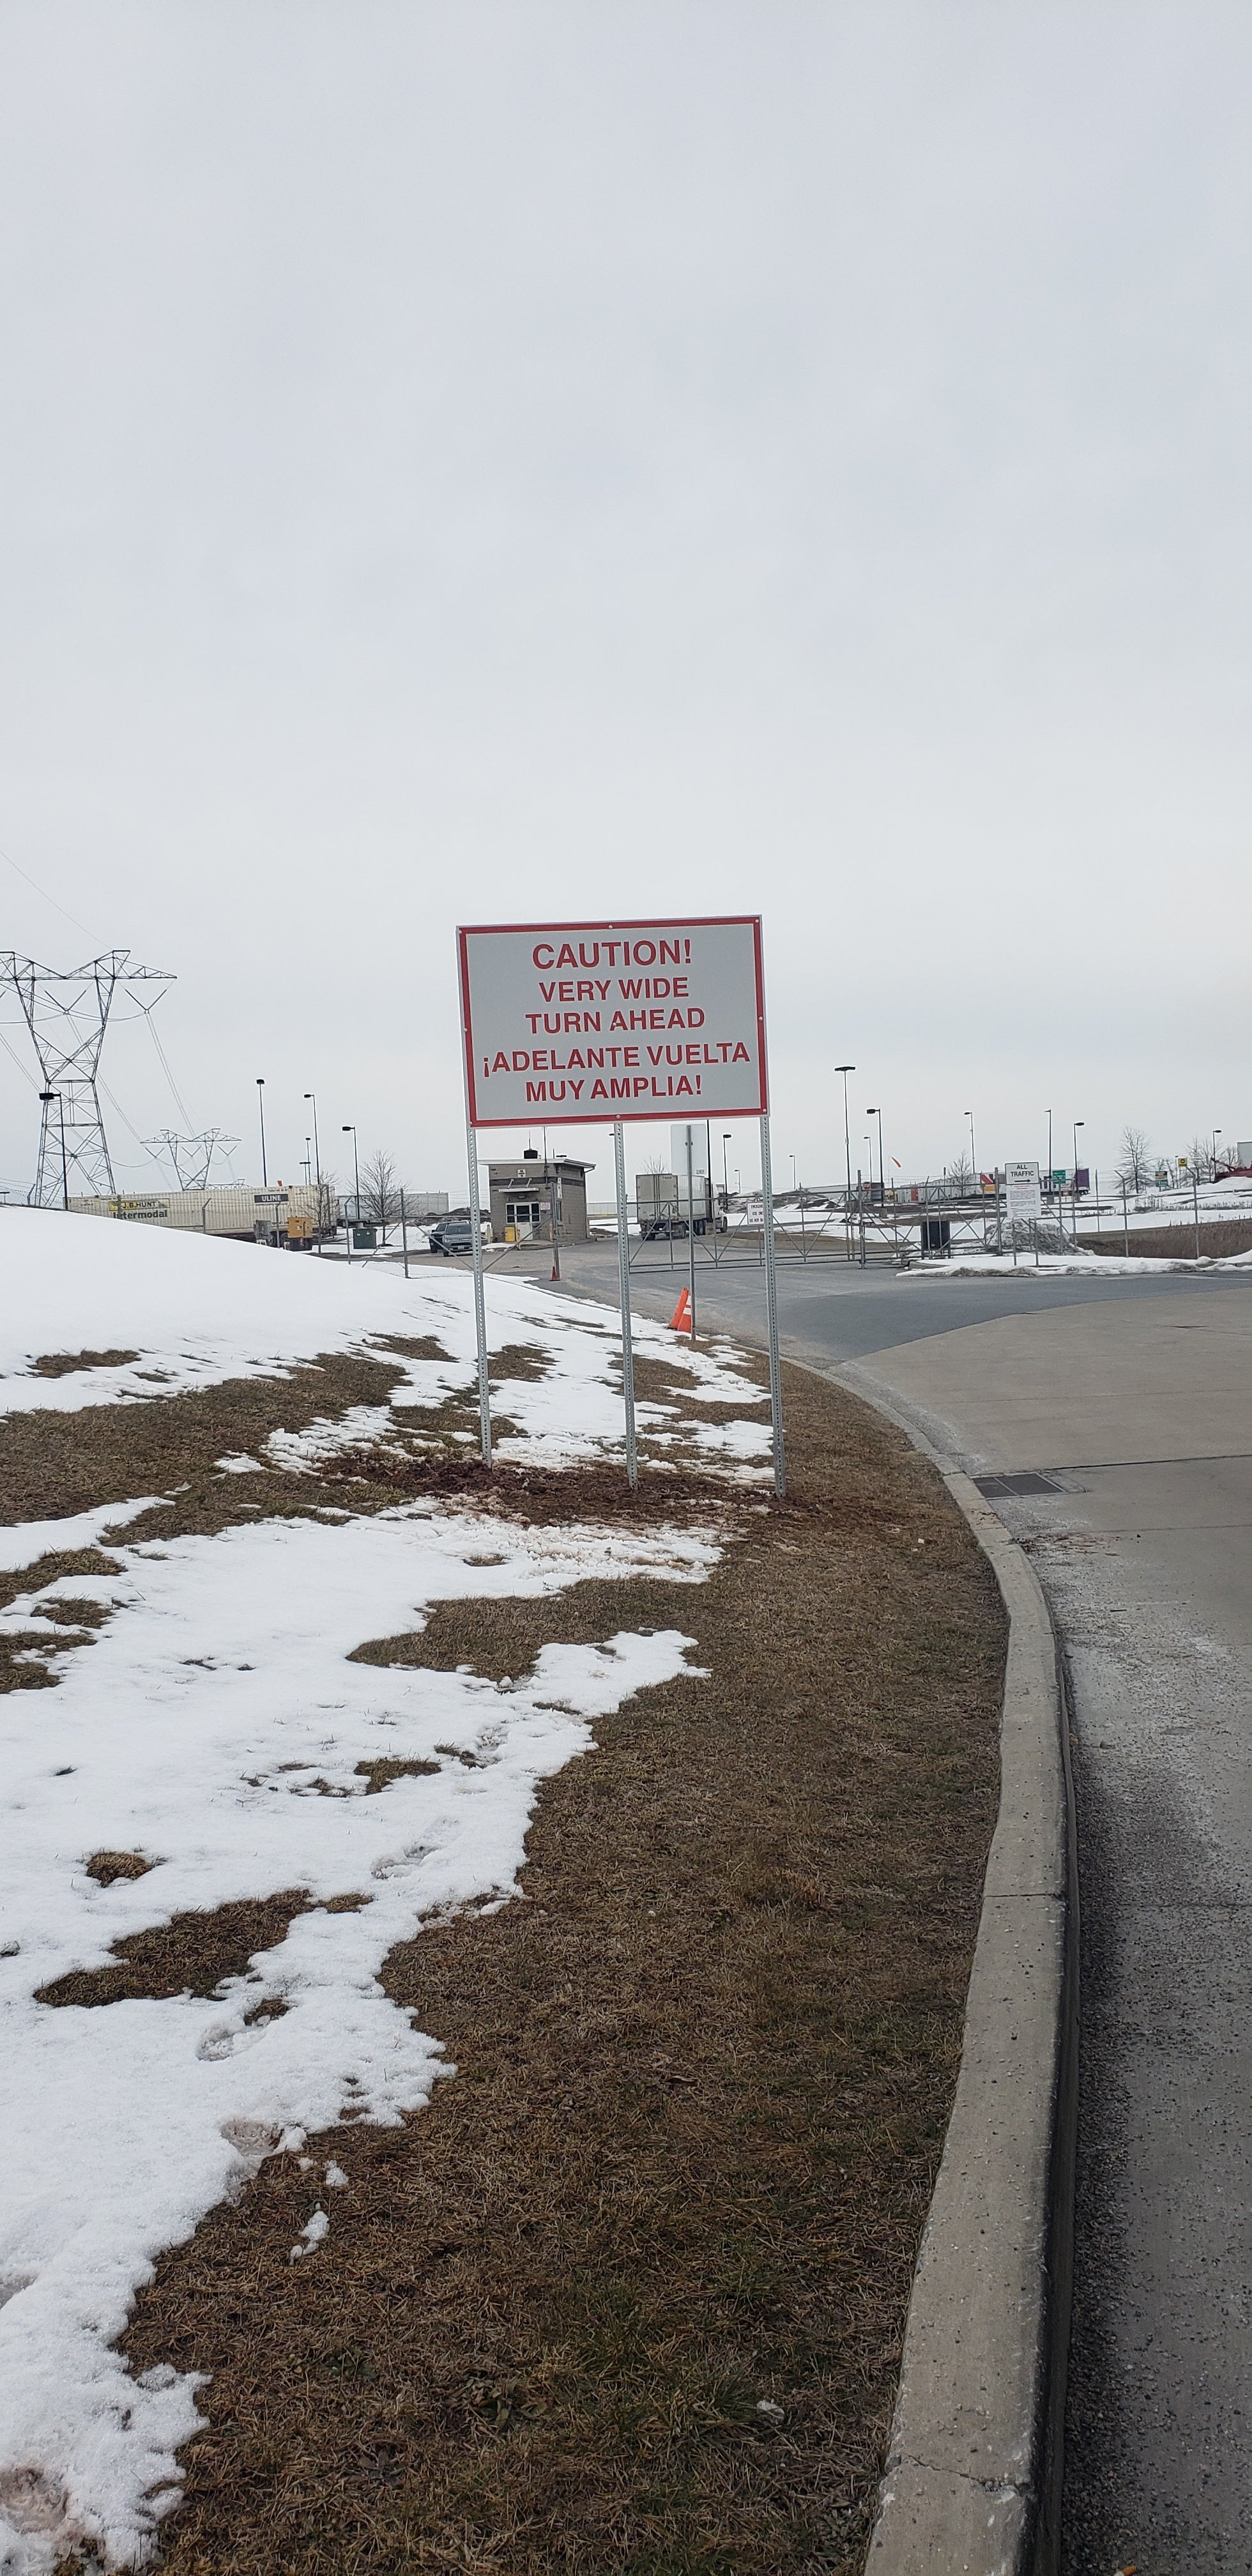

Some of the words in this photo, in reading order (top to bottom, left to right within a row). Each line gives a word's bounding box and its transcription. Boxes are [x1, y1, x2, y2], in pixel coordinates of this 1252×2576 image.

[532, 939, 691, 970] CAUTION!
[539, 979, 611, 1002] VERY
[618, 977, 689, 999] WIDE
[525, 1011, 601, 1034] TURN
[609, 1008, 705, 1031] AHEAD
[483, 1046, 639, 1078] ¡ADELANTE
[646, 1042, 750, 1066] VUELTA
[525, 1078, 584, 1102] MUY
[590, 1075, 701, 1099] AMPLIA!
